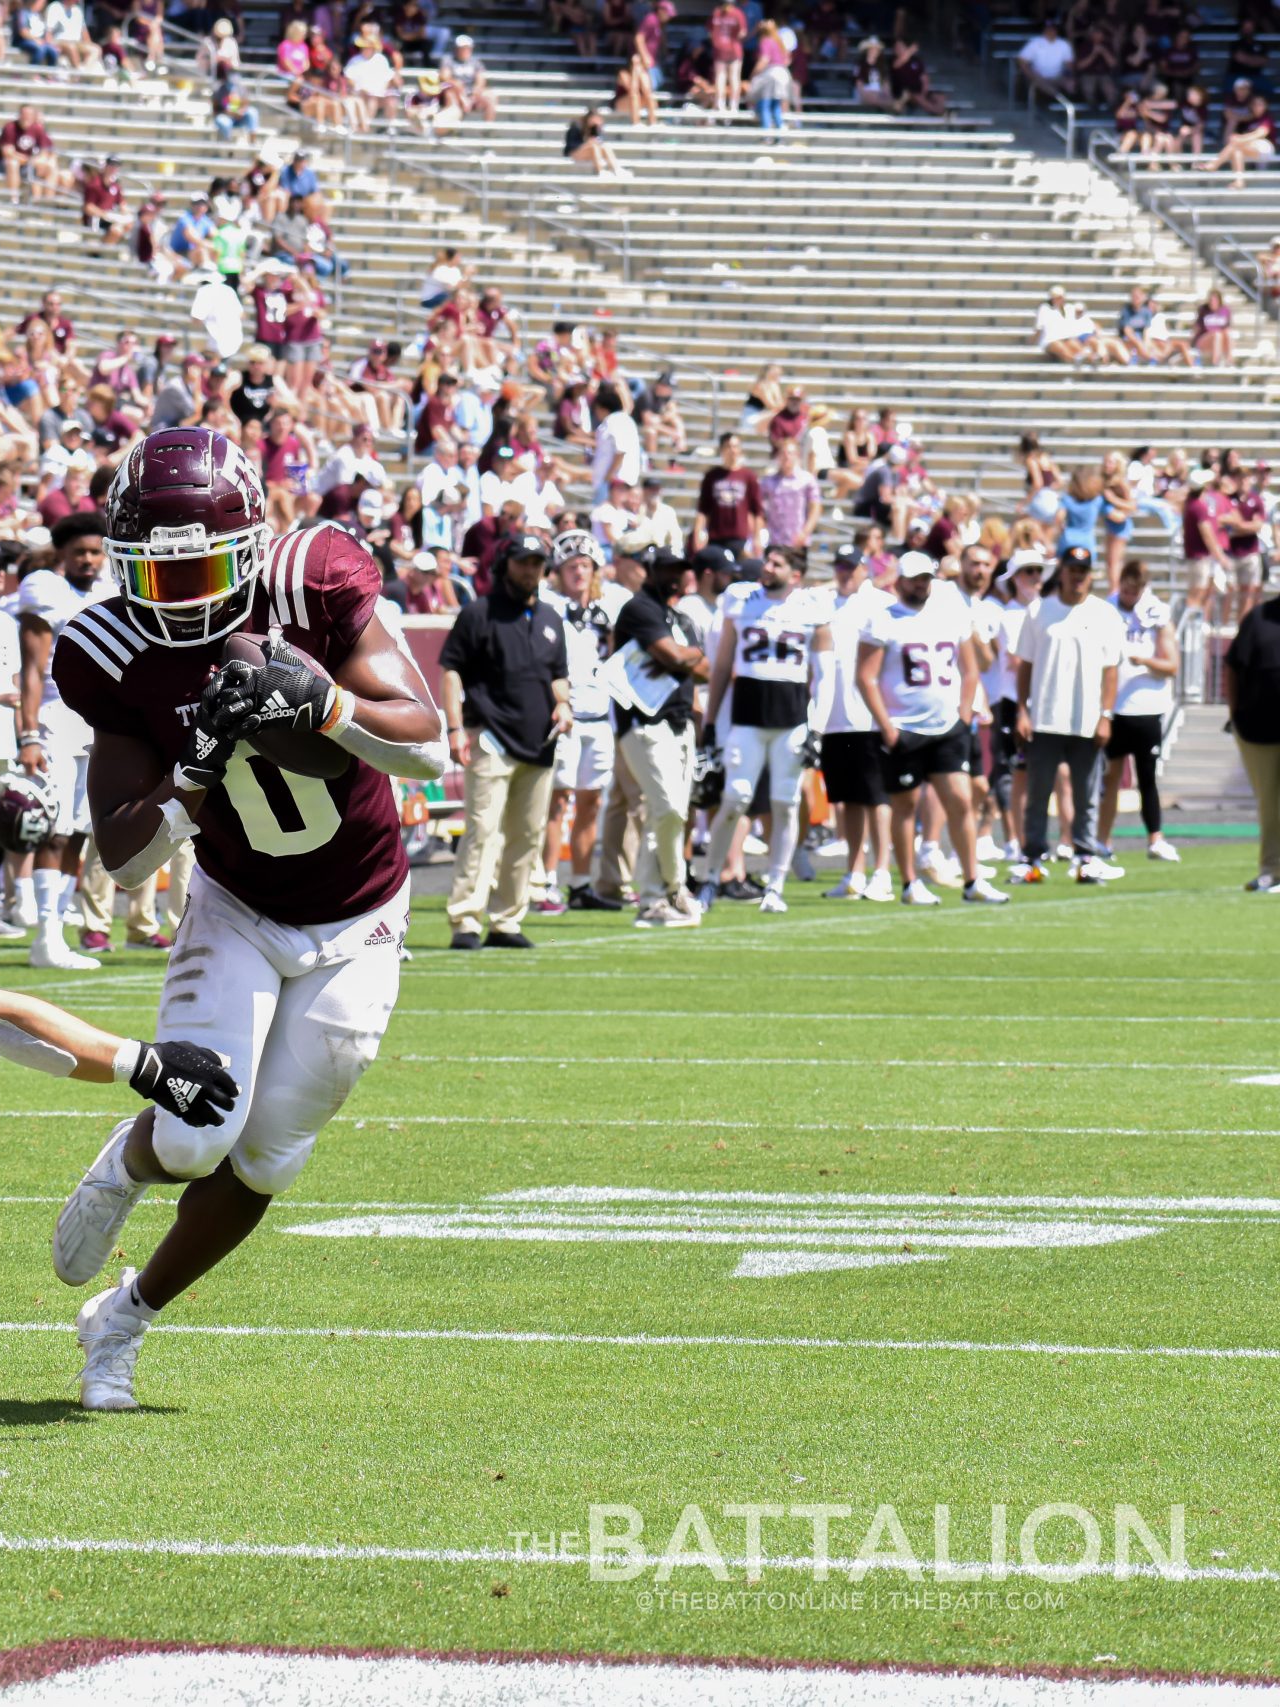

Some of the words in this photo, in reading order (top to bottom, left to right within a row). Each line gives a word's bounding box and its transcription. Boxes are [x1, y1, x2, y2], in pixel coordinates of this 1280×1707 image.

[167, 529, 190, 539] AGGIES
[901, 641, 958, 687] 63
[259, 707, 297, 722] adidas
[197, 736, 219, 761] adidas
[221, 738, 342, 858] 0
[364, 935, 396, 946] adidas
[166, 1077, 189, 1113] adidas
